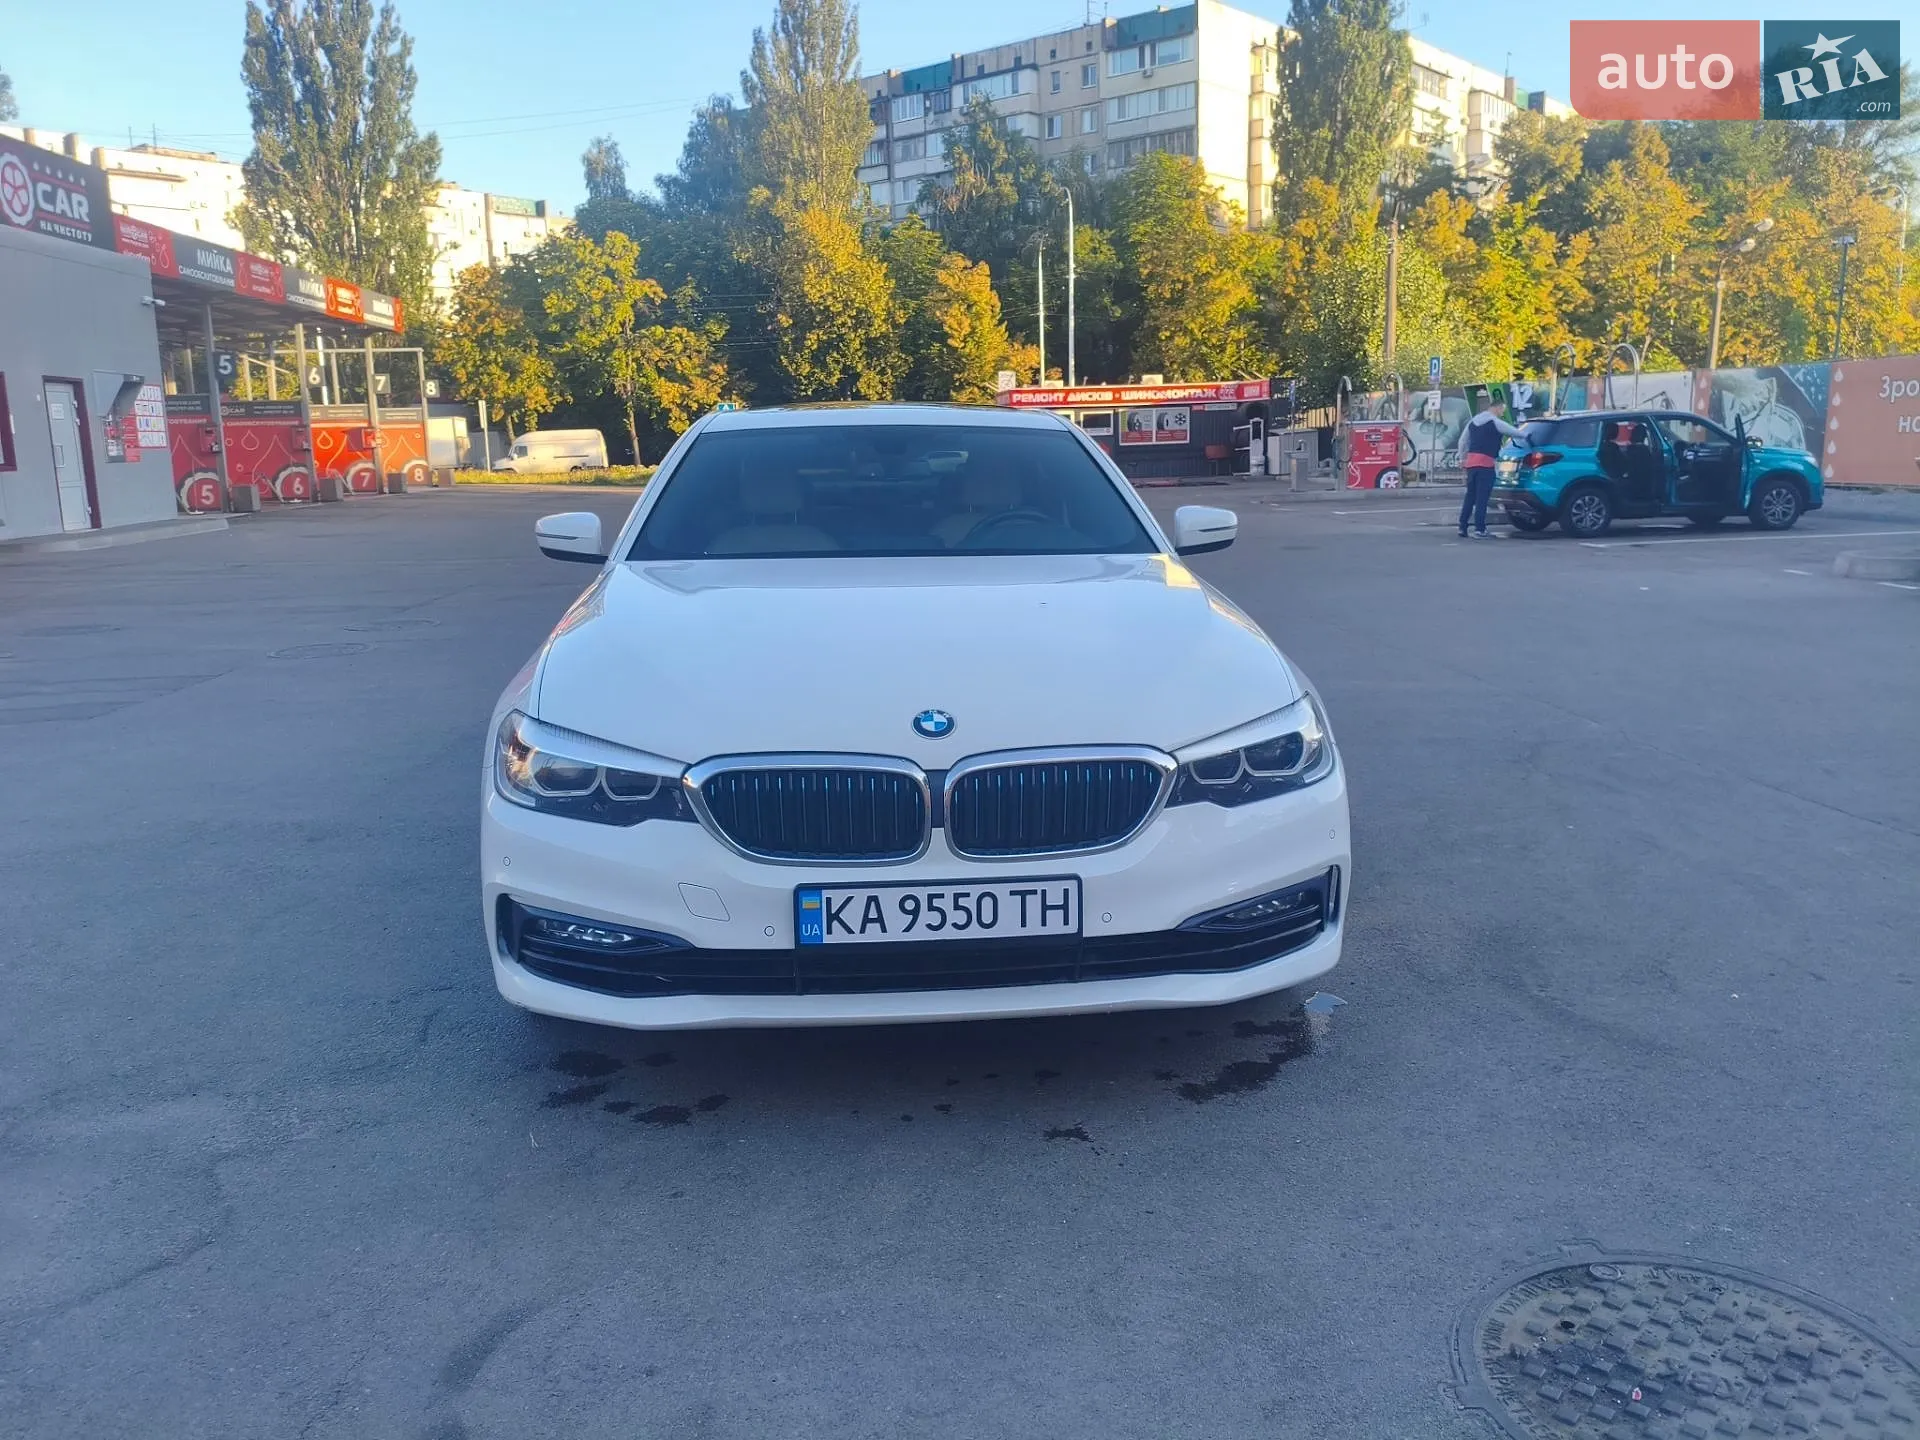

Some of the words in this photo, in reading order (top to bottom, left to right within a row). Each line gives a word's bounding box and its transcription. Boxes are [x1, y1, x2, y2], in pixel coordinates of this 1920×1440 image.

[36, 181, 91, 223] CAR
[39, 219, 52, 233] НА
[52, 223, 93, 243] ЧИСТОТУ
[197, 249, 234, 275] МИЙКА
[218, 354, 233, 375] 5
[308, 367, 321, 385] 6
[375, 375, 387, 392] 7
[425, 381, 437, 396] 8
[1012, 392, 1066, 403] РЕМОНТ
[1510, 383, 1533, 409] 12
[359, 471, 371, 488] 7
[413, 468, 424, 482] 8
[200, 484, 214, 505] 5
[292, 477, 305, 495] 6
[826, 894, 888, 935] KA
[898, 891, 999, 933] 9550
[1009, 887, 1070, 929] TH
[802, 923, 821, 937] UA
